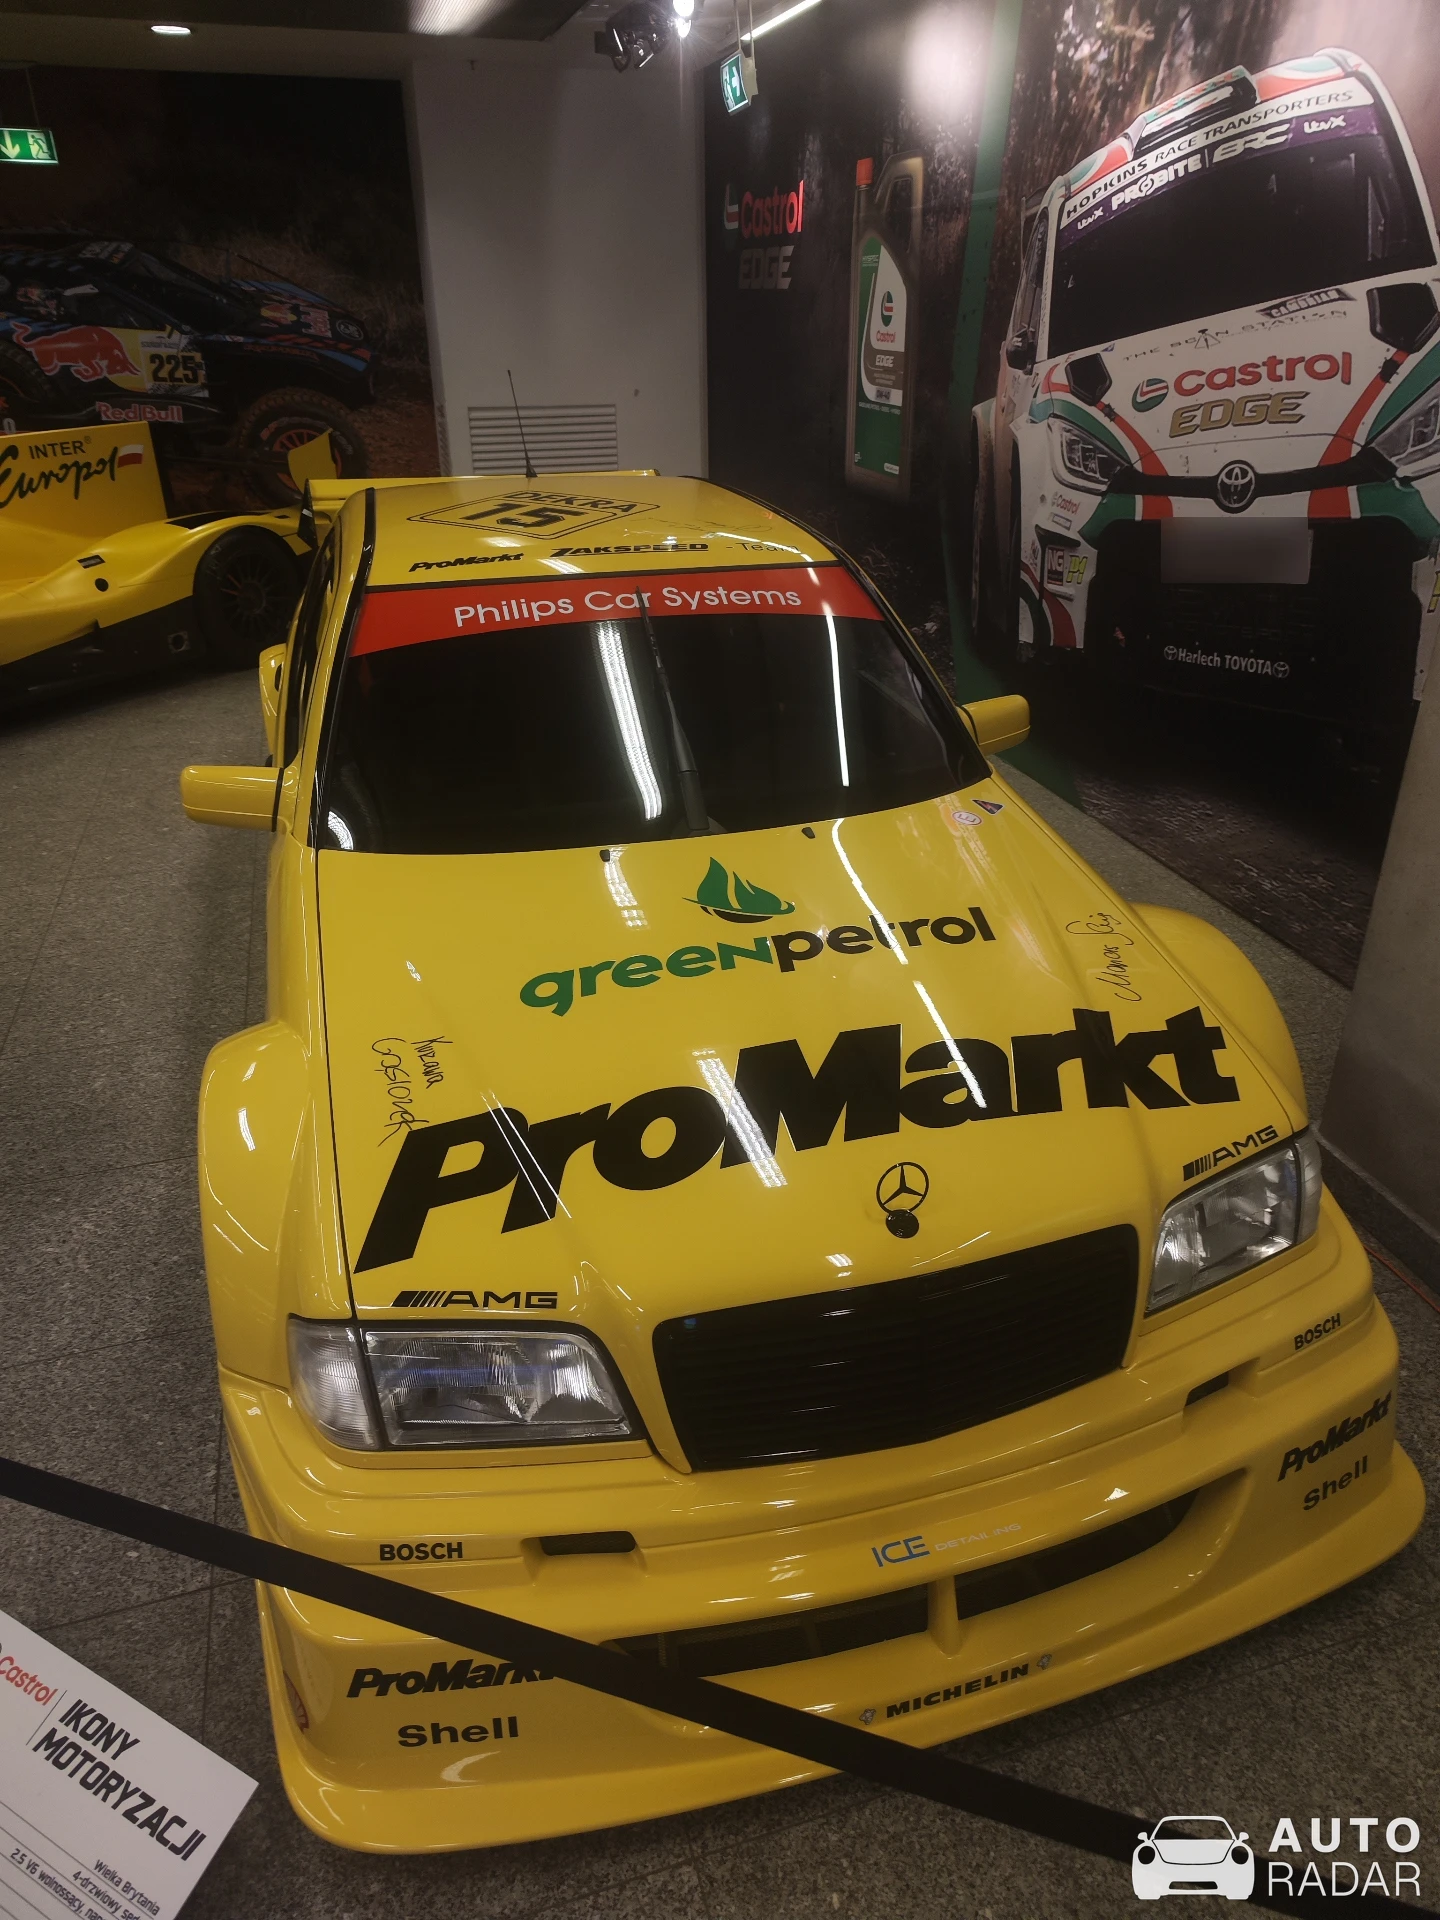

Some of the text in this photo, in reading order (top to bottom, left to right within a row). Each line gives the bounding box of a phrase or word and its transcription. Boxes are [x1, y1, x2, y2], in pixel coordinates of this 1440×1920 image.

[1067, 89, 1353, 219] HOPKINS RACE TRANSPORTERS
[741, 179, 804, 238] Castrol
[739, 245, 794, 289] EDGE
[876, 330, 896, 343] Castrol
[149, 353, 199, 384] 225
[875, 354, 895, 367] EDGE
[1173, 351, 1352, 397] Castrol
[96, 401, 183, 423] Red Bull
[1169, 391, 1310, 438] EDGE
[459, 502, 588, 528] 15
[503, 491, 637, 513] DEKRA
[1056, 495, 1080, 515] Castrol
[408, 552, 524, 572] ProMarkt
[549, 543, 709, 558] ZAKSPEED
[454, 586, 801, 627] Philips Car Systems
[1178, 647, 1272, 676] Harlech TOYOTA
[520, 907, 996, 1017] greenpetrol
[354, 1006, 1240, 1274] ProMarkt
[1212, 1125, 1279, 1167] AMG
[441, 1291, 558, 1309] AMG
[1294, 1313, 1341, 1351] BOSCH
[1277, 1390, 1392, 1482] ProMarkt
[1303, 1455, 1368, 1511] Shell
[379, 1541, 463, 1561] BOSCH
[871, 1523, 1022, 1567] ICE DETAILING
[0, 1656, 58, 1706] Castrol
[886, 1663, 1029, 1719] MICHELIN
[58, 1699, 140, 1761] IKONY
[398, 1716, 519, 1747] Shell
[32, 1727, 207, 1861] MOTORYZACJI
[10, 1848, 27, 1865] 2.5
[26, 1858, 40, 1875] V6
[72, 1871, 122, 1914] 4-drzwiowy
[94, 1859, 160, 1916] Wielka Brytania
